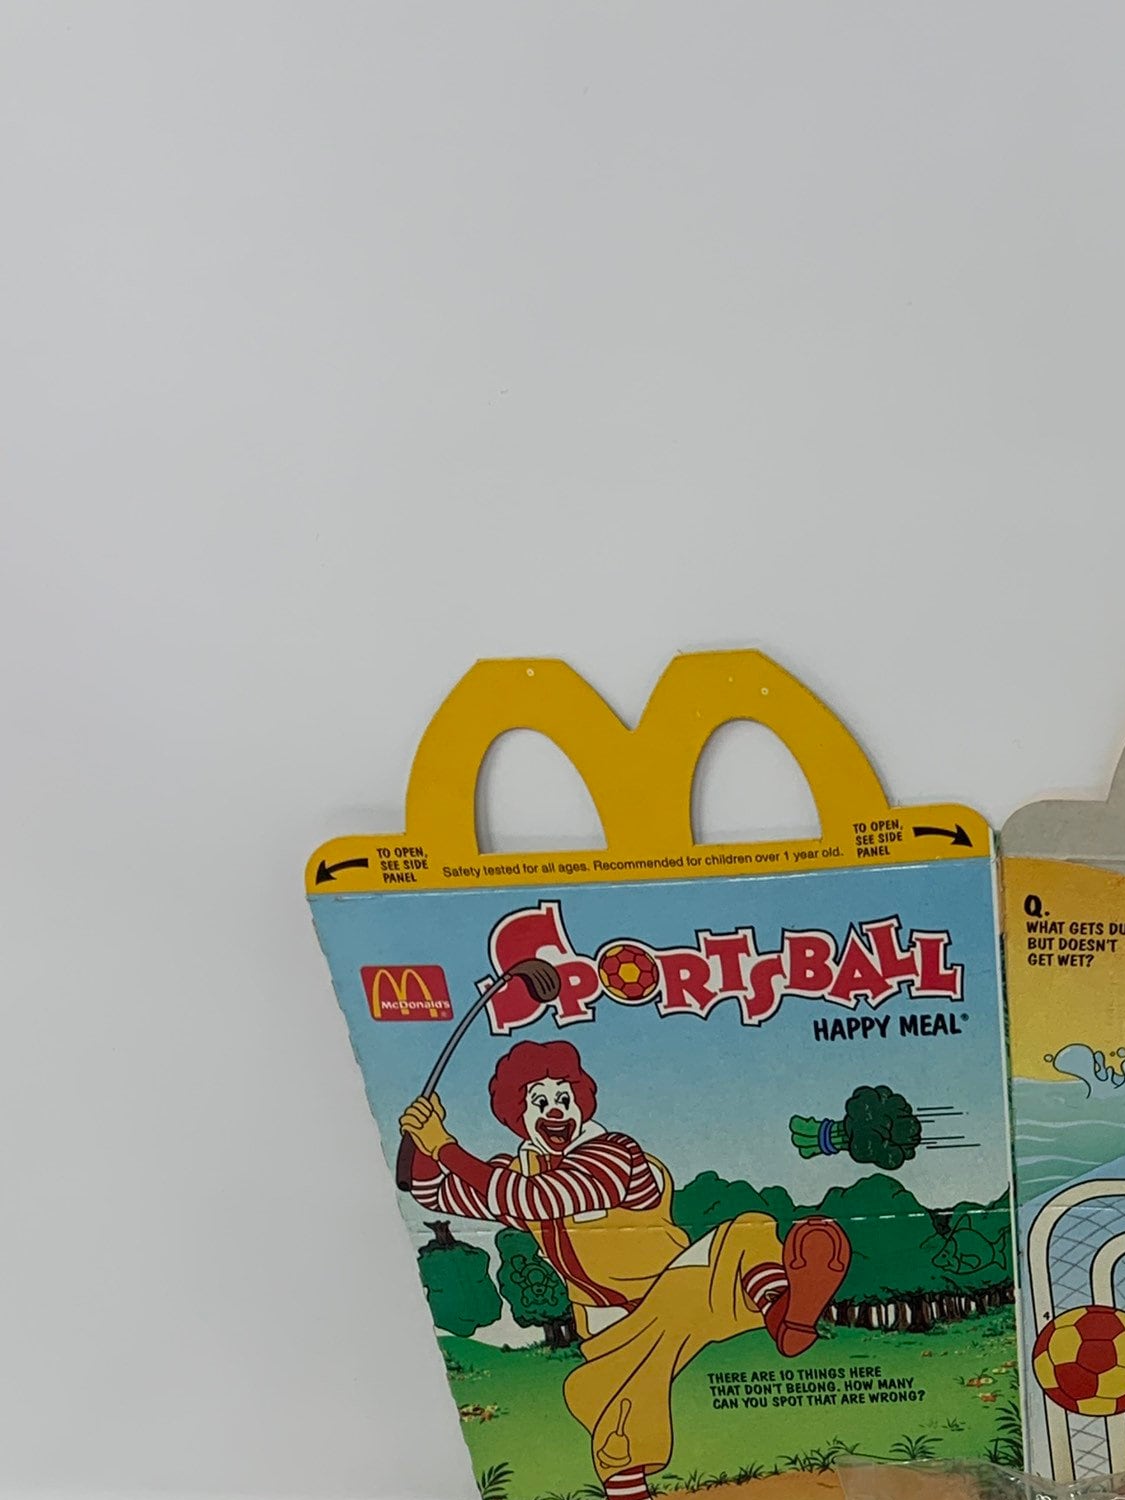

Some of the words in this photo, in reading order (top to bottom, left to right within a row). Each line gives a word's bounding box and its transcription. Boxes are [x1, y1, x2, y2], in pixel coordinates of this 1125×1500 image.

[853, 823, 867, 834] TO
[870, 819, 903, 832] OPEN,
[855, 835, 874, 846] SEE
[878, 832, 903, 843] SIDE
[376, 848, 391, 859] TO
[394, 847, 428, 859] OPEN,
[857, 846, 890, 858] PANEL
[380, 861, 400, 871] SEE
[403, 859, 428, 870] SIDE
[442, 866, 481, 879] Safety
[483, 864, 521, 876] tested
[523, 862, 539, 875] for
[541, 862, 555, 873] all
[558, 863, 590, 876] ages.
[593, 856, 684, 872] Recommended
[686, 853, 701, 866] for
[704, 851, 752, 865] children
[755, 852, 780, 863] over
[783, 850, 790, 861] 1
[793, 851, 818, 863] year
[821, 847, 844, 858] old.
[383, 872, 417, 884] PANEL
[1024, 894, 1050, 918] Q.
[1026, 920, 1065, 935] WHAT
[1069, 921, 1104, 935] GETS
[1027, 937, 1055, 950] BUT
[1058, 938, 1118, 953] DOESN'T
[476, 900, 965, 1036] SPORTSBALL
[1027, 953, 1055, 966] GET
[1057, 954, 1095, 968] WET?
[381, 1000, 451, 1010] McDonald's
[813, 1014, 891, 1041] HAPPY
[707, 1371, 747, 1384] THERE
[751, 1370, 775, 1382] ARE
[780, 1369, 794, 1381] 10
[797, 1367, 845, 1380] THINGS
[849, 1366, 882, 1378] HERE
[709, 1384, 741, 1397] THAT
[744, 1383, 783, 1395] DON'T
[786, 1381, 841, 1394] BELONG.
[845, 1379, 873, 1392] HOW
[877, 1377, 914, 1390] MANY
[712, 1398, 739, 1410] CAN
[741, 1397, 768, 1409] YOU
[772, 1395, 803, 1408] SPOT
[806, 1394, 837, 1406] THAT
[840, 1392, 865, 1405] ARE
[868, 1390, 926, 1403] WRONG?
